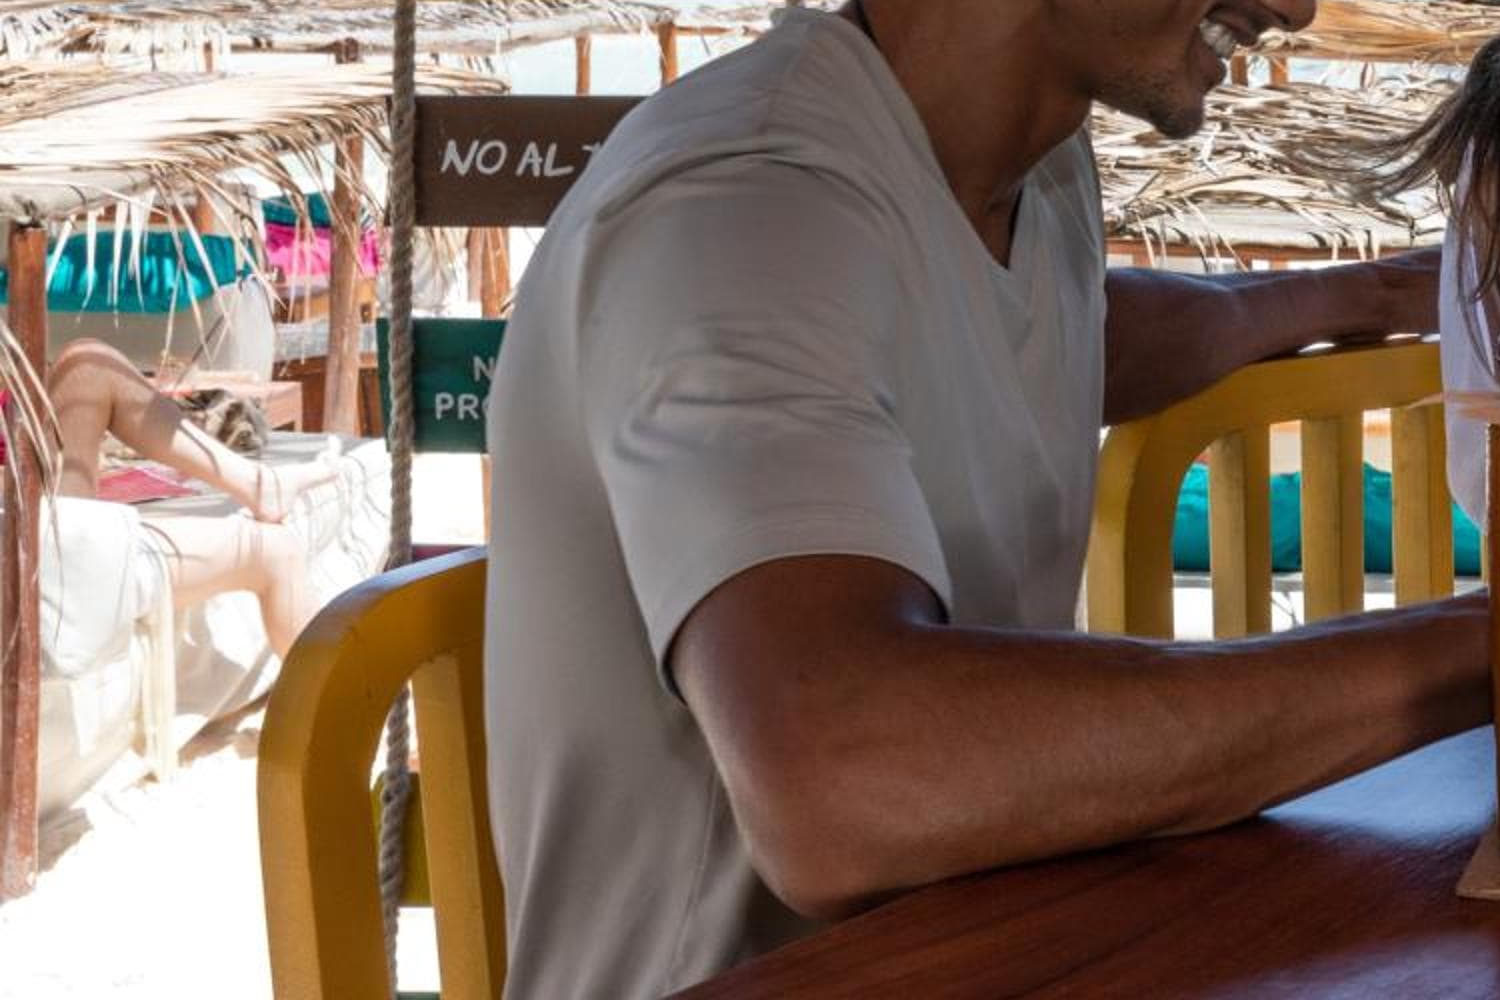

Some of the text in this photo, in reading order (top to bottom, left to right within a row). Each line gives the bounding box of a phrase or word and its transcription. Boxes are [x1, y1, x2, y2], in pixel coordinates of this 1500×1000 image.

[440, 139, 574, 177] NO AL
[473, 355, 497, 383] N
[434, 391, 490, 420] PR
